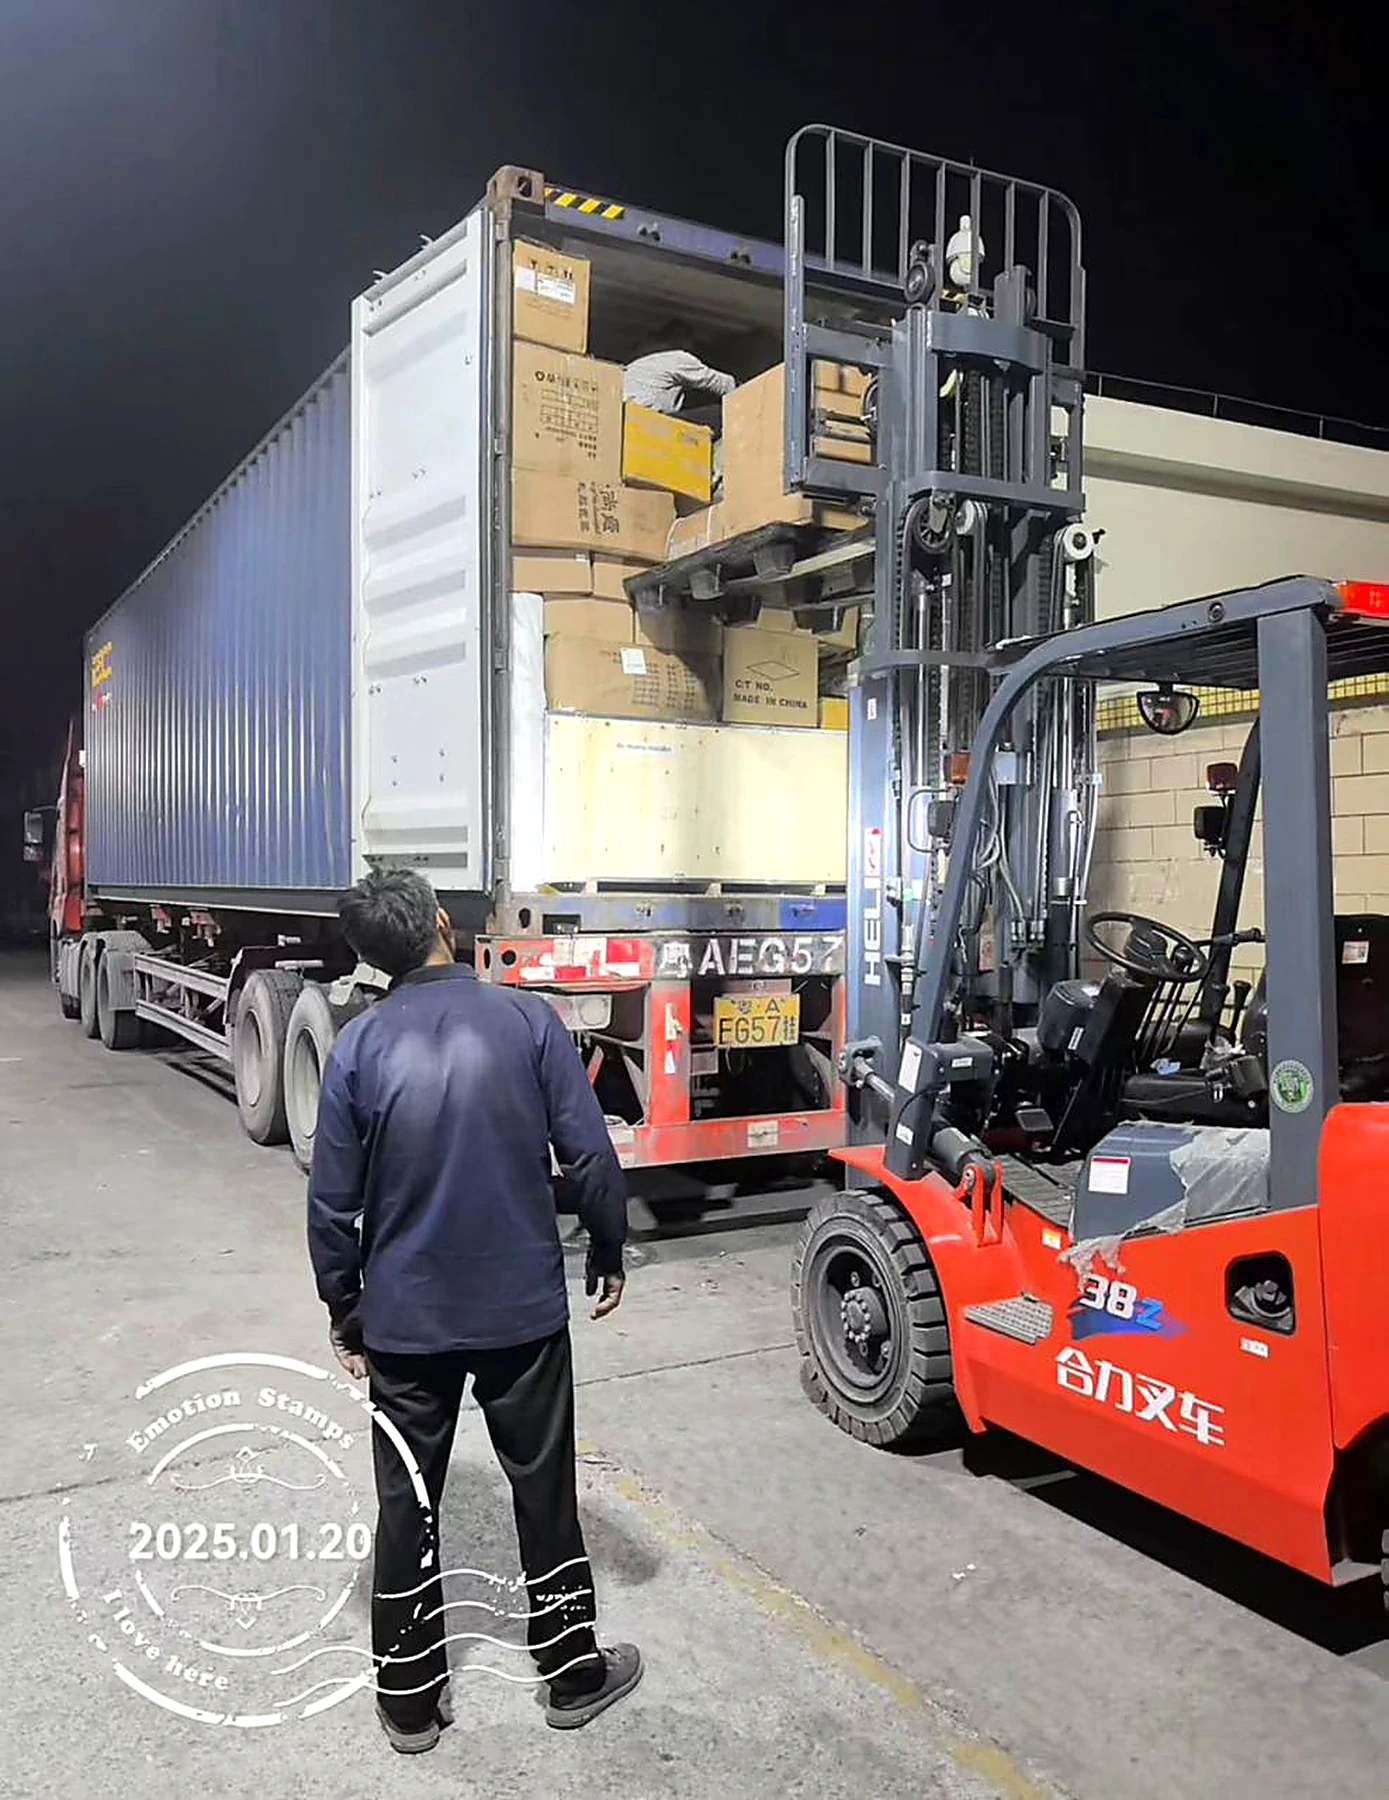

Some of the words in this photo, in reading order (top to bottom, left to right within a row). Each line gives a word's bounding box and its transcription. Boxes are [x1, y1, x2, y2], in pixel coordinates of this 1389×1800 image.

[733, 693, 760, 704] MADE
[765, 696, 777, 706] IN
[779, 698, 808, 709] CHINA
[755, 681, 773, 692] NO.
[864, 877, 881, 985] HELI
[1055, 1346, 1225, 1447] 合力叉车
